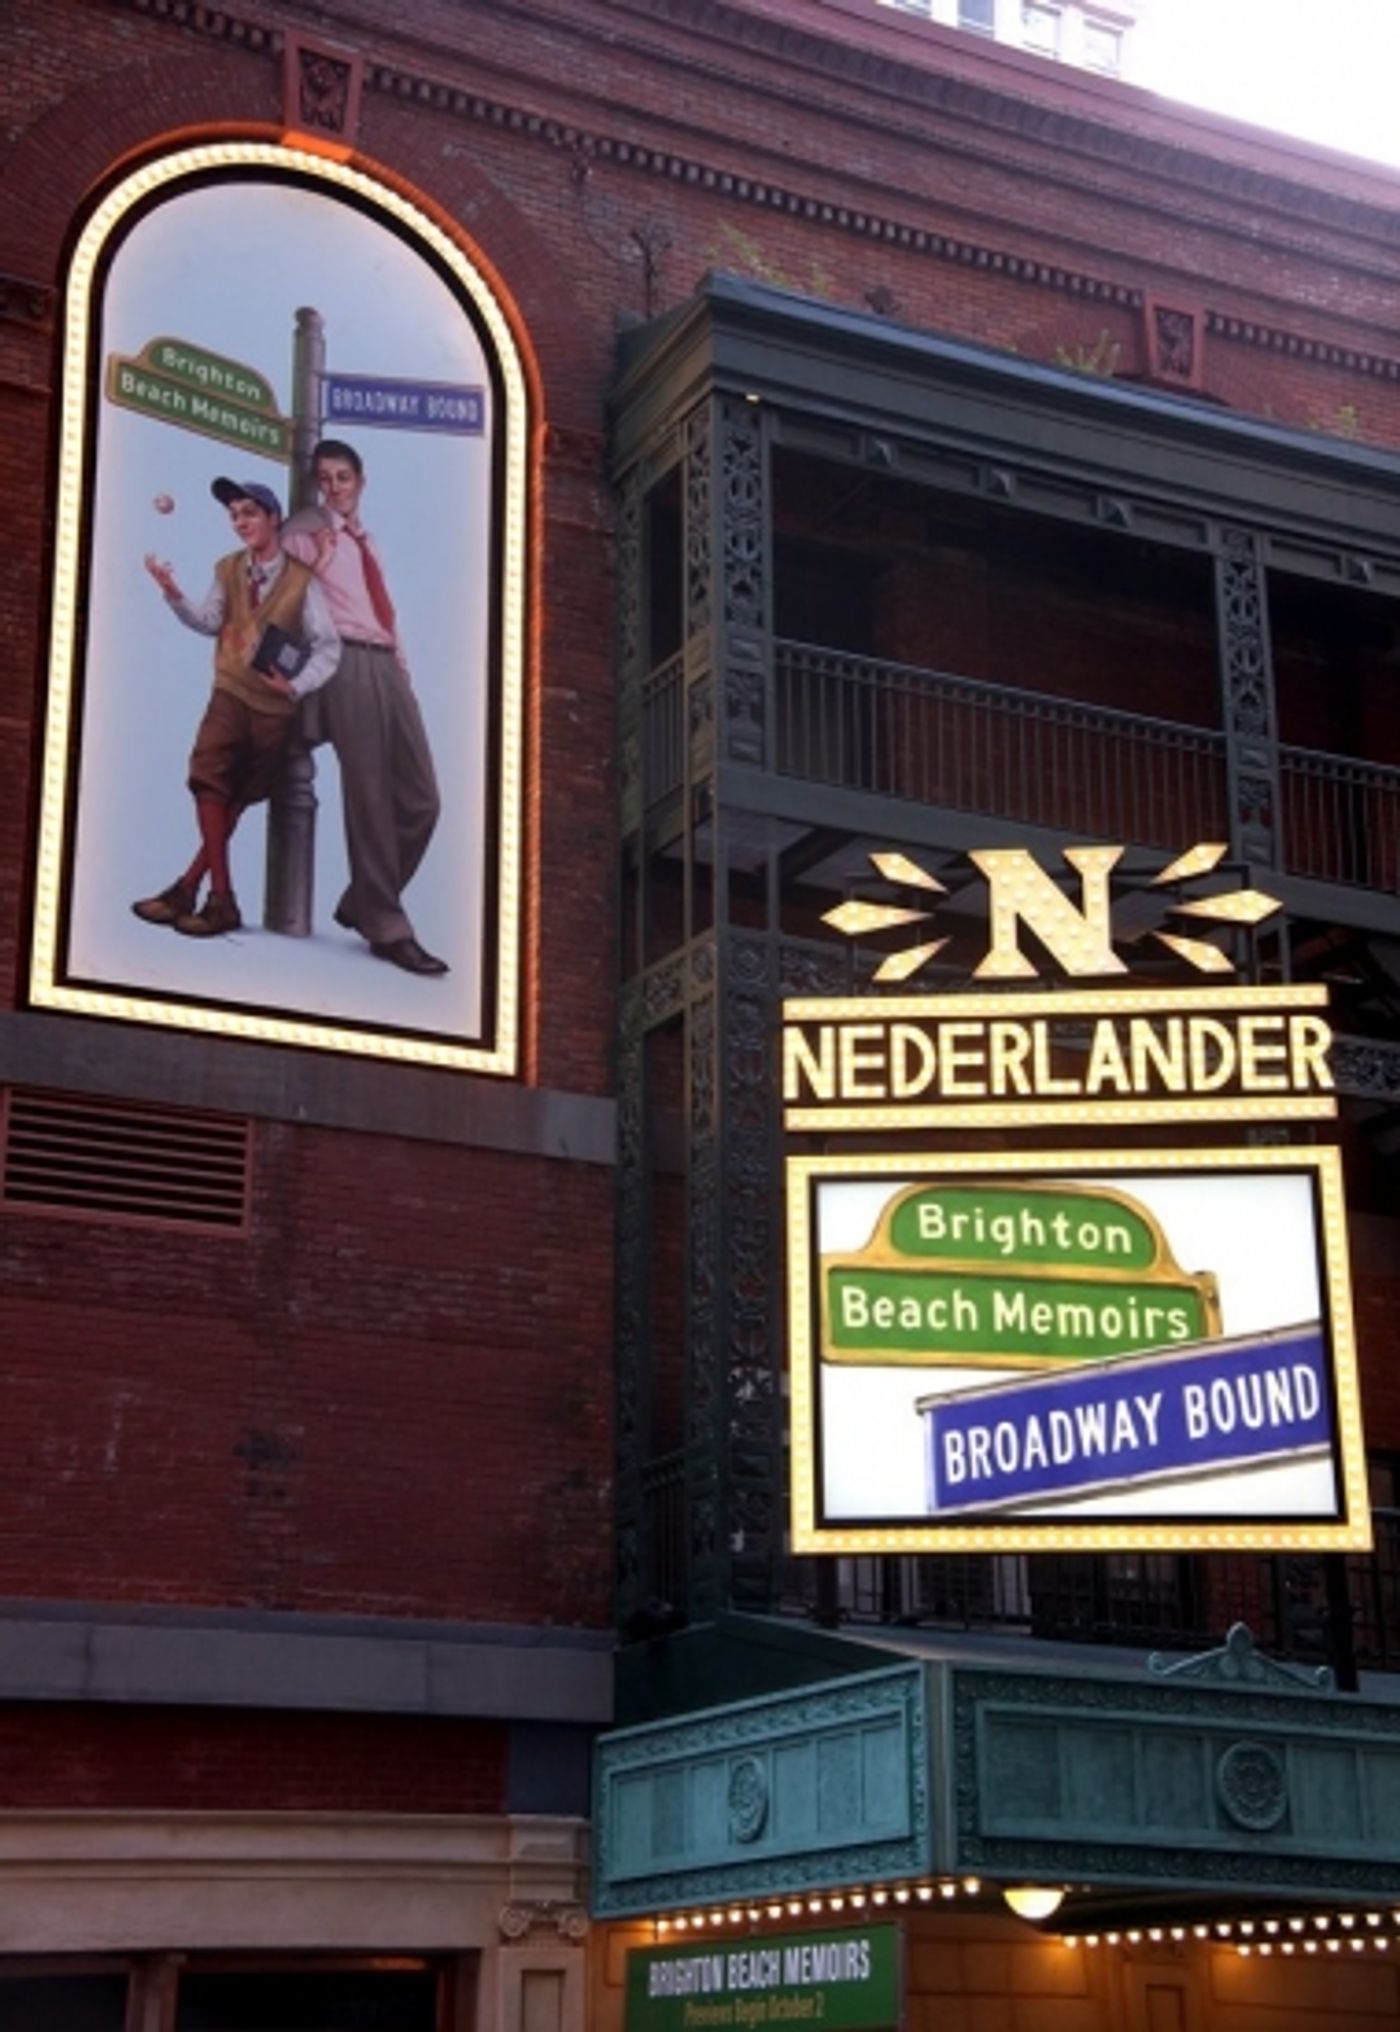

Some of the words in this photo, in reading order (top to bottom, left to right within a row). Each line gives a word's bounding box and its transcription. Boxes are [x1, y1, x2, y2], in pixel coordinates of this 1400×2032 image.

[161, 346, 261, 400] Brighton
[120, 371, 188, 411] Beach
[192, 399, 281, 446] Memoirs
[332, 387, 420, 416] BROADWAY
[427, 393, 479, 422] BOUND
[968, 846, 1130, 978] N
[783, 1014, 1335, 1099] NEDERLANDER
[918, 1203, 1133, 1255] Brighton
[840, 1286, 978, 1332] Beach
[993, 1291, 1191, 1340] Memoirs
[944, 1392, 1163, 1484] BROADWAY
[1183, 1364, 1320, 1439] BOUND
[649, 1955, 723, 1997] BRIGHTON
[727, 1949, 780, 1989] BEACH
[783, 1939, 870, 1985] MEMOIRS
